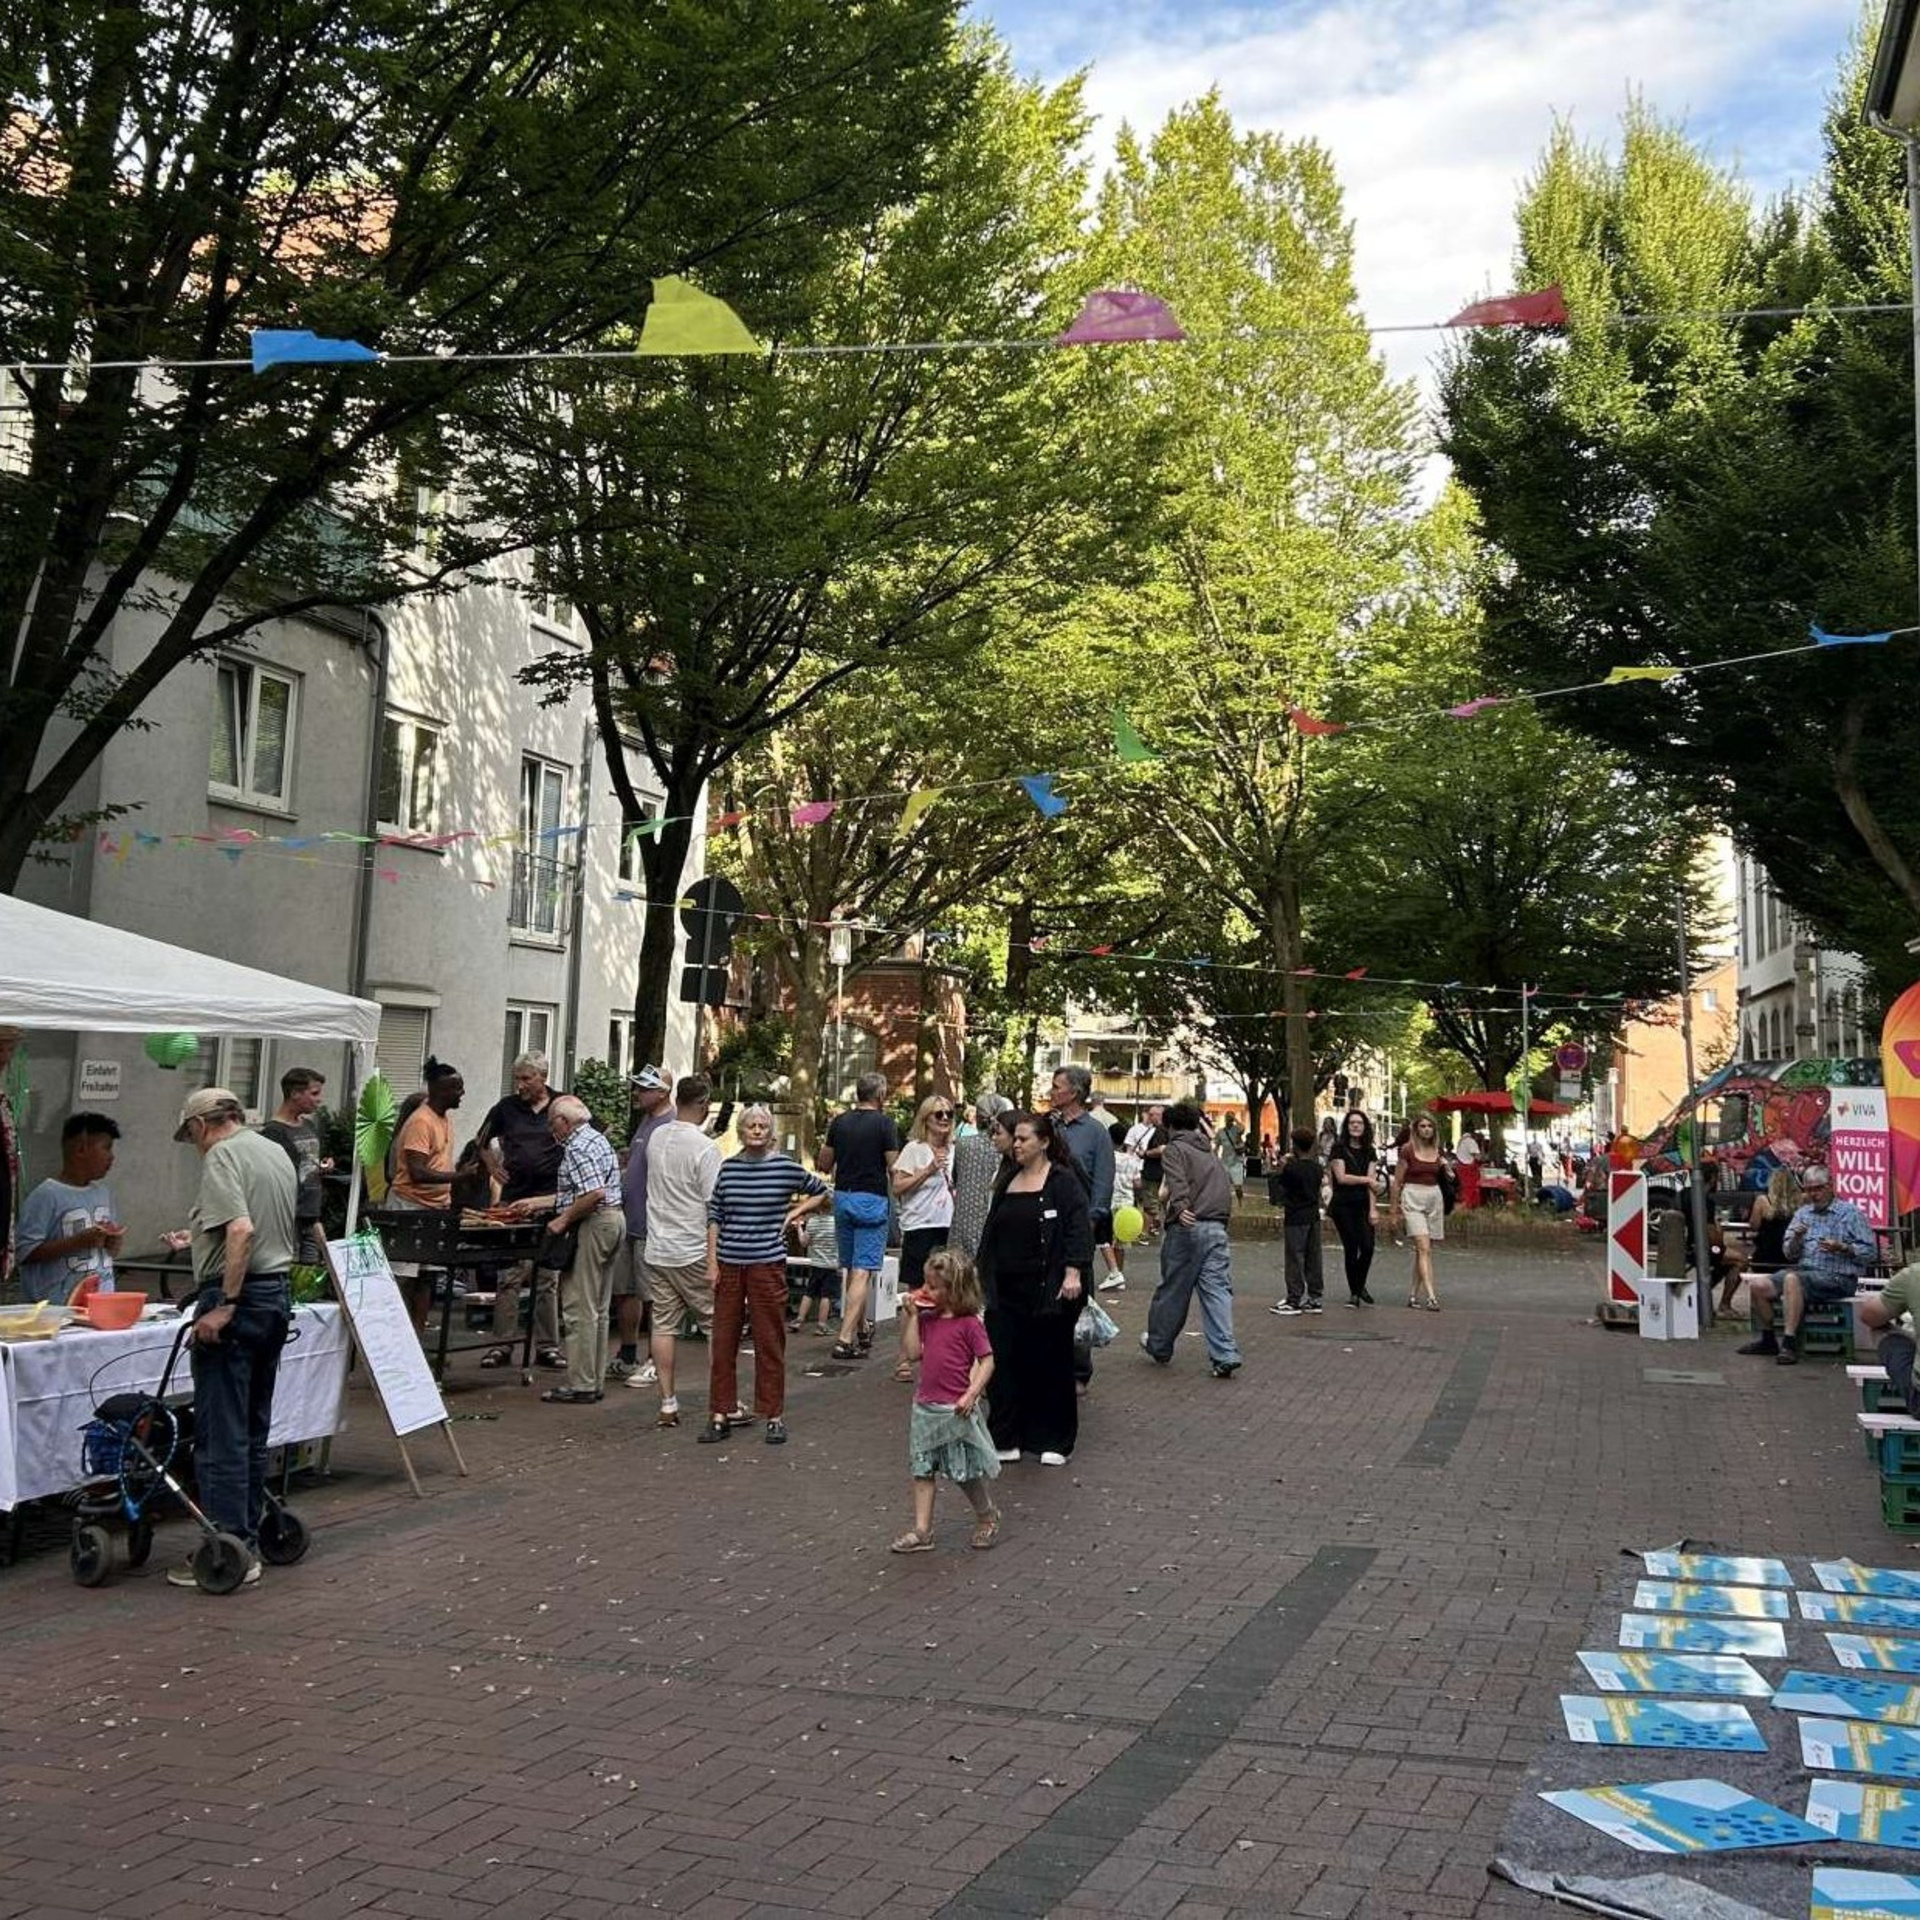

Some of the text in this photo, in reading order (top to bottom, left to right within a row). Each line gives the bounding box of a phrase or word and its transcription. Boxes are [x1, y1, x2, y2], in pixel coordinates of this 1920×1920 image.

[1853, 1103, 1876, 1117] VIVA
[1835, 1135, 1886, 1148] HERZLICH
[1835, 1150, 1885, 1172] WILL
[1836, 1173, 1884, 1196] KOM
[1847, 1197, 1884, 1219] EN
